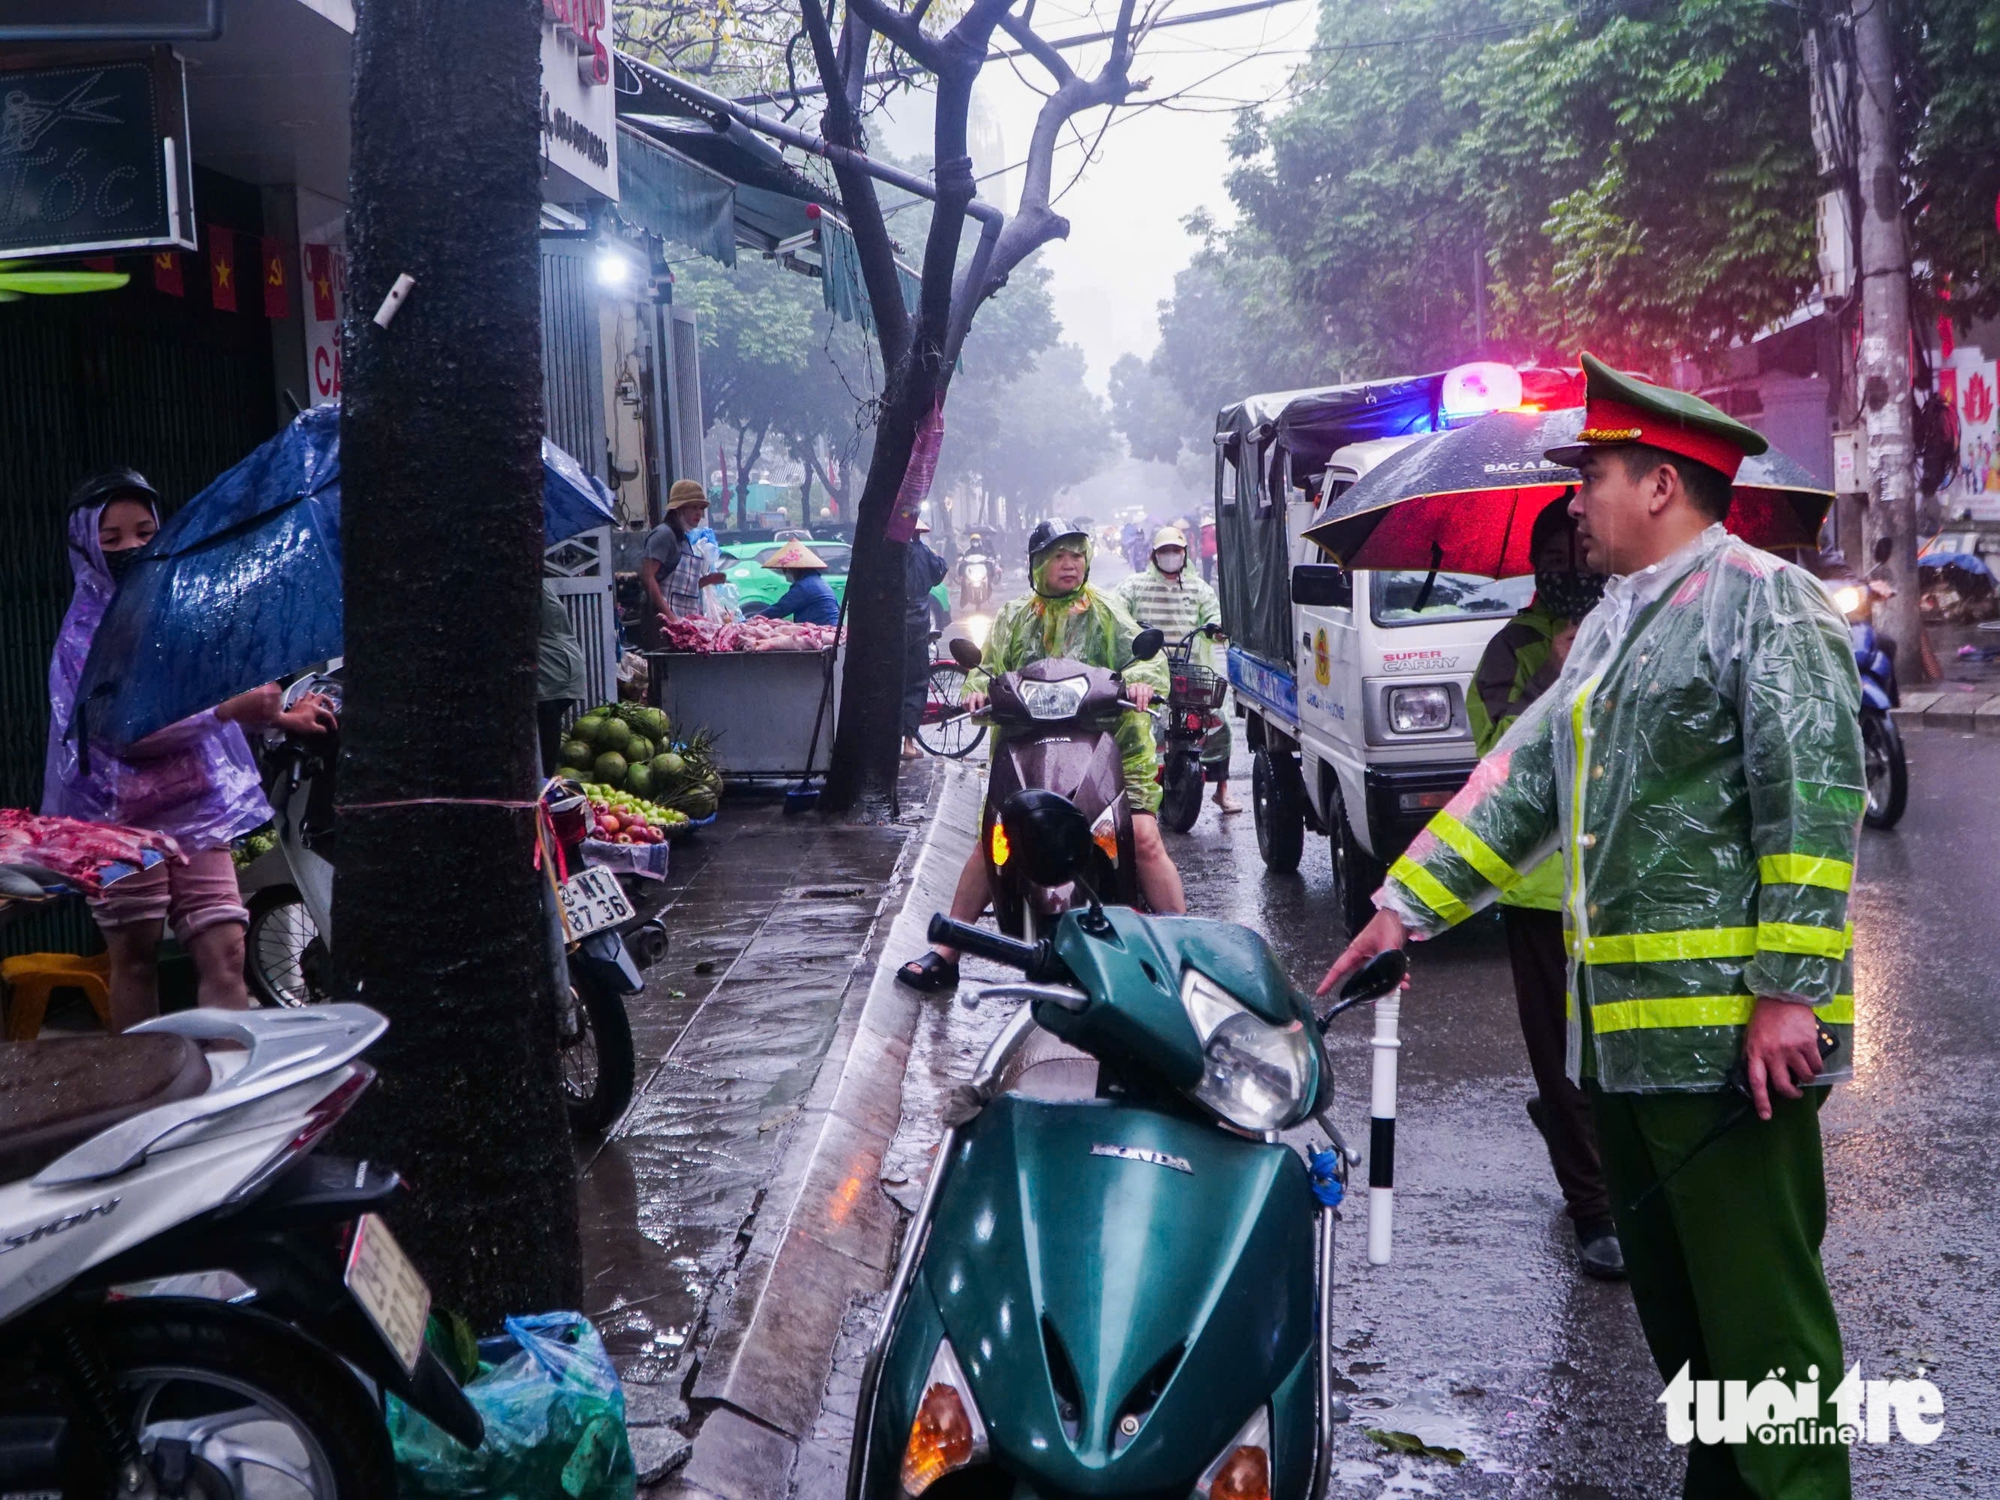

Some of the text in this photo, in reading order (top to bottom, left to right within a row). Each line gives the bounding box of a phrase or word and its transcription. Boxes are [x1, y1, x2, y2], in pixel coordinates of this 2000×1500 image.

[1484, 462, 1520, 473] BAC
[1523, 461, 1537, 470] A
[1383, 650, 1442, 662] SUPER
[1383, 656, 1459, 673] CARRY
[1090, 1143, 1195, 1175] HONDA
